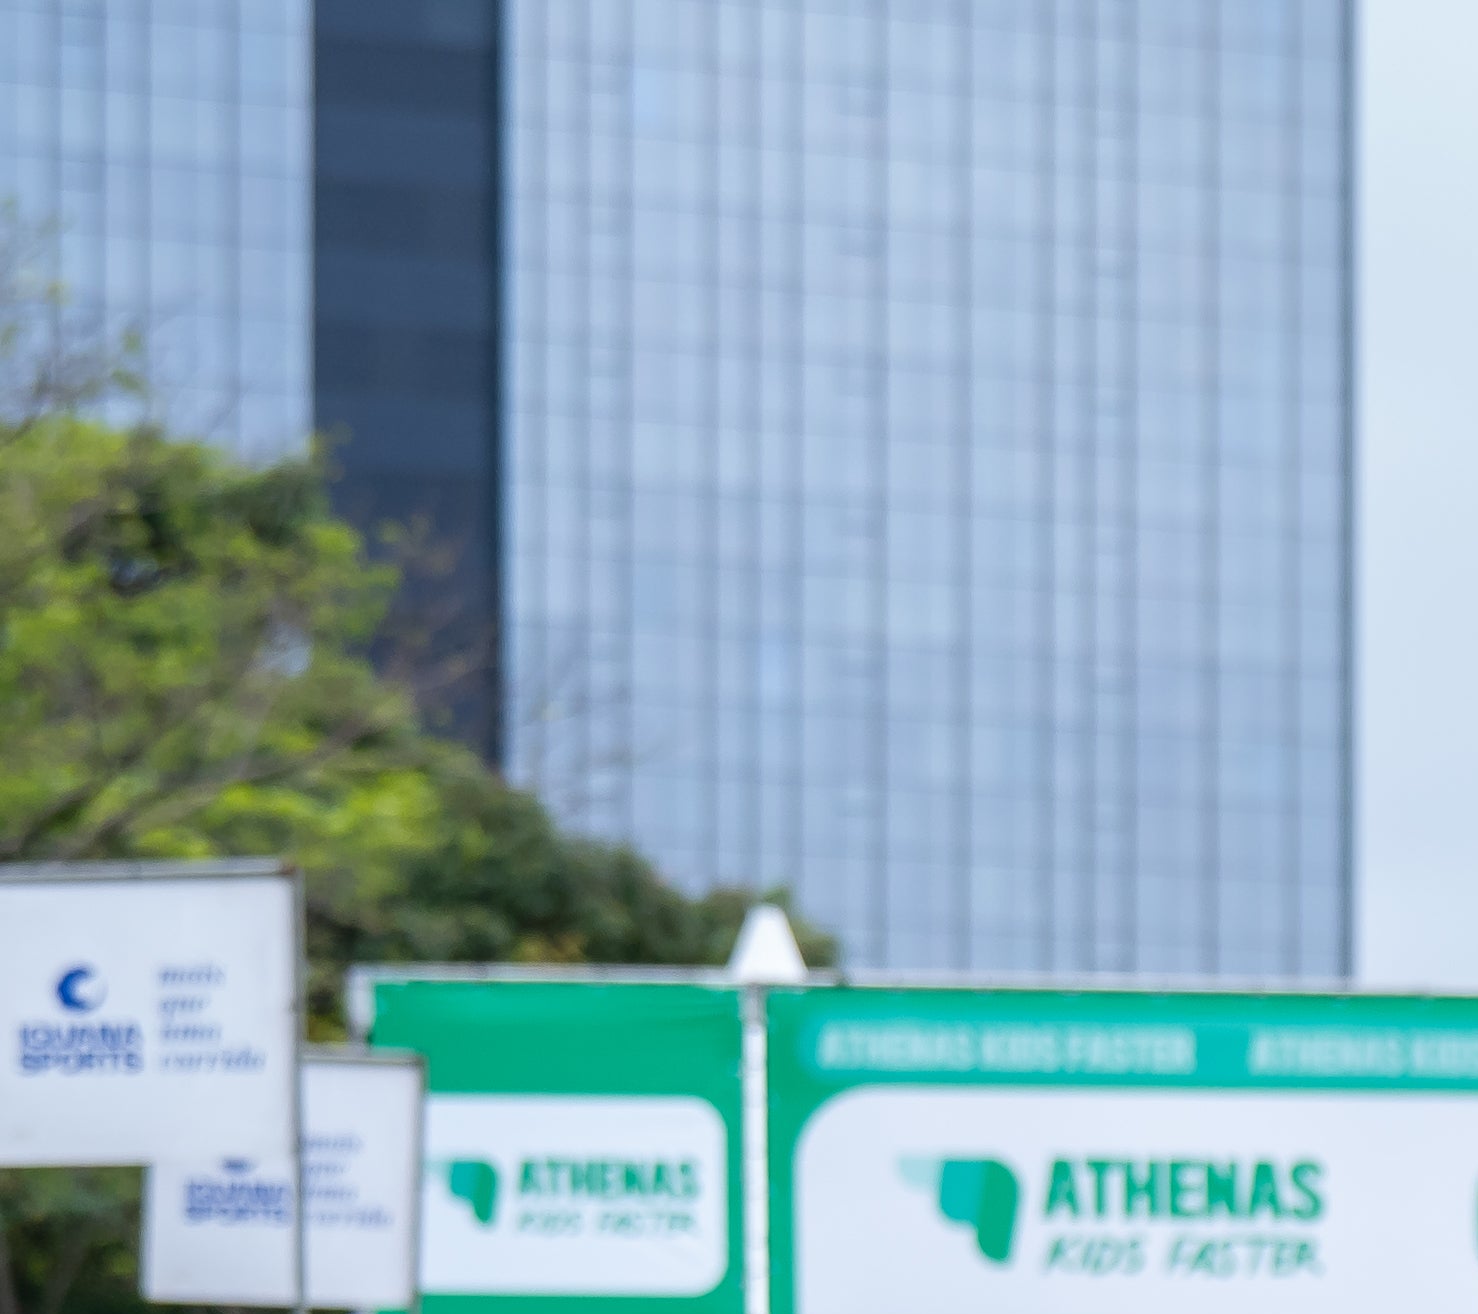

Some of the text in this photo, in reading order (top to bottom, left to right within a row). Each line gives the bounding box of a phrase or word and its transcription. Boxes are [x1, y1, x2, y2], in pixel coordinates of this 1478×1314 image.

[517, 1154, 700, 1202] ATHENAS
[1043, 1158, 1326, 1221] ATHENAS
[1044, 1233, 1325, 1277] KIDS FASTER
